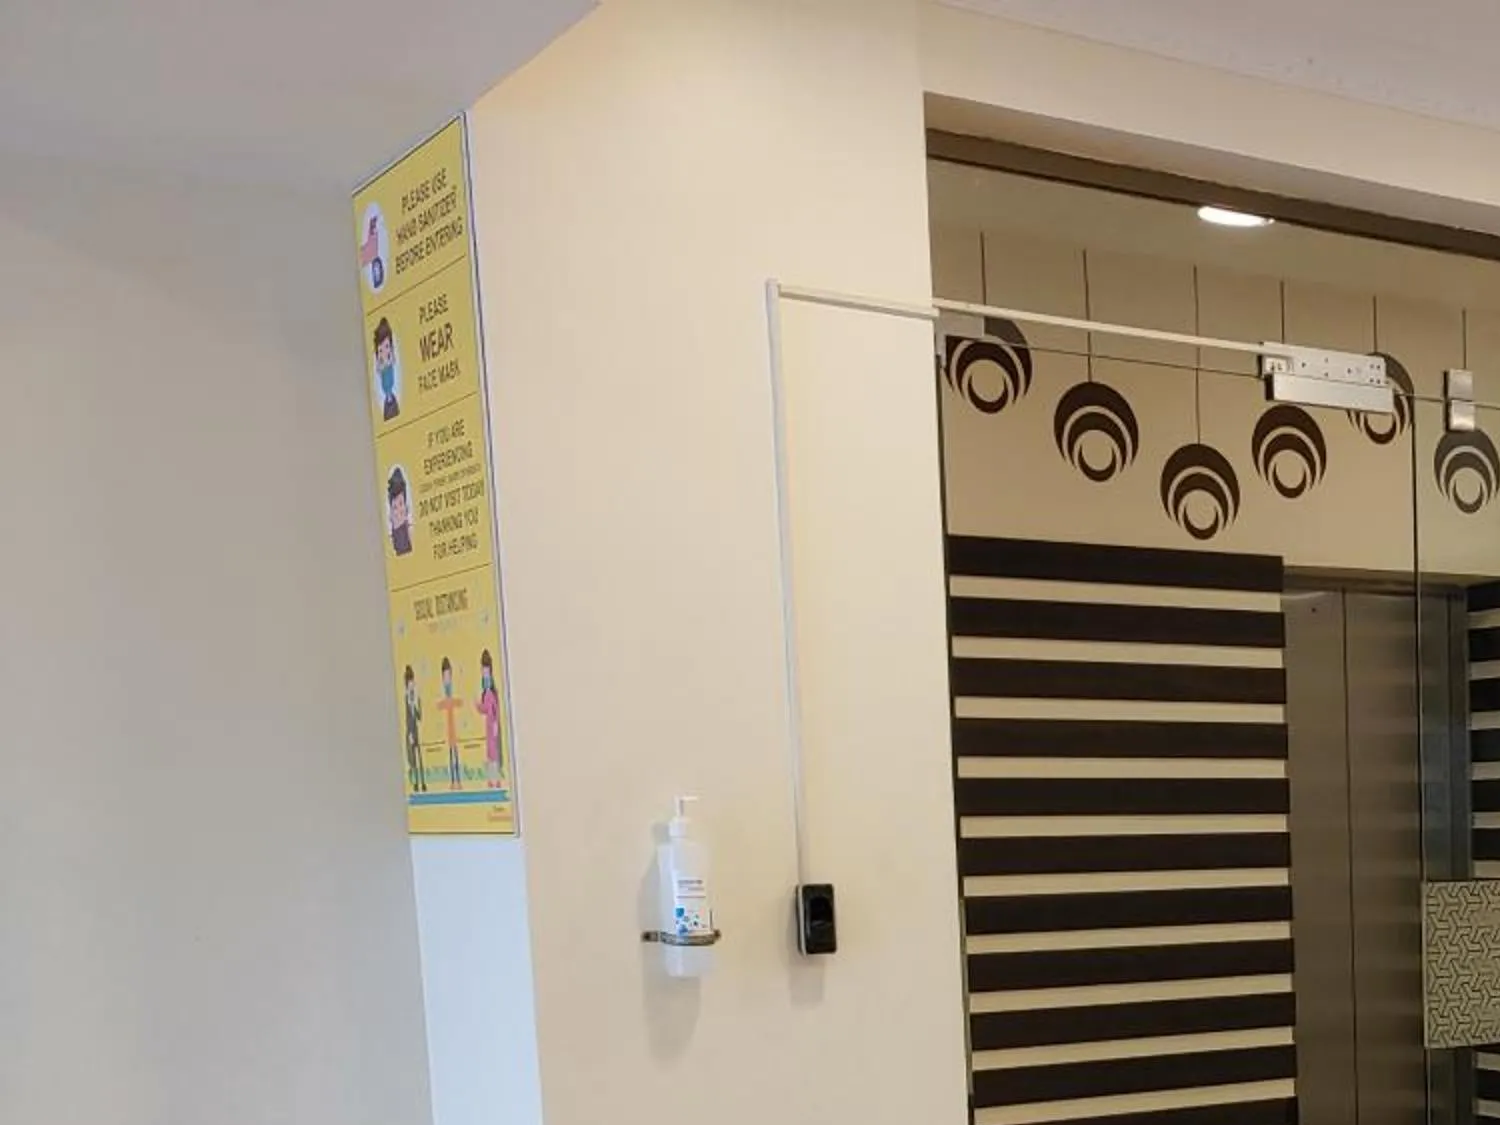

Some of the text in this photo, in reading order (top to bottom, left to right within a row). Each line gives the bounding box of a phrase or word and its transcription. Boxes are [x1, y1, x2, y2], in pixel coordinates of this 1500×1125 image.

[402, 180, 430, 214] PLEASE
[419, 293, 448, 325] PLEASE
[419, 322, 454, 362] WEAR
